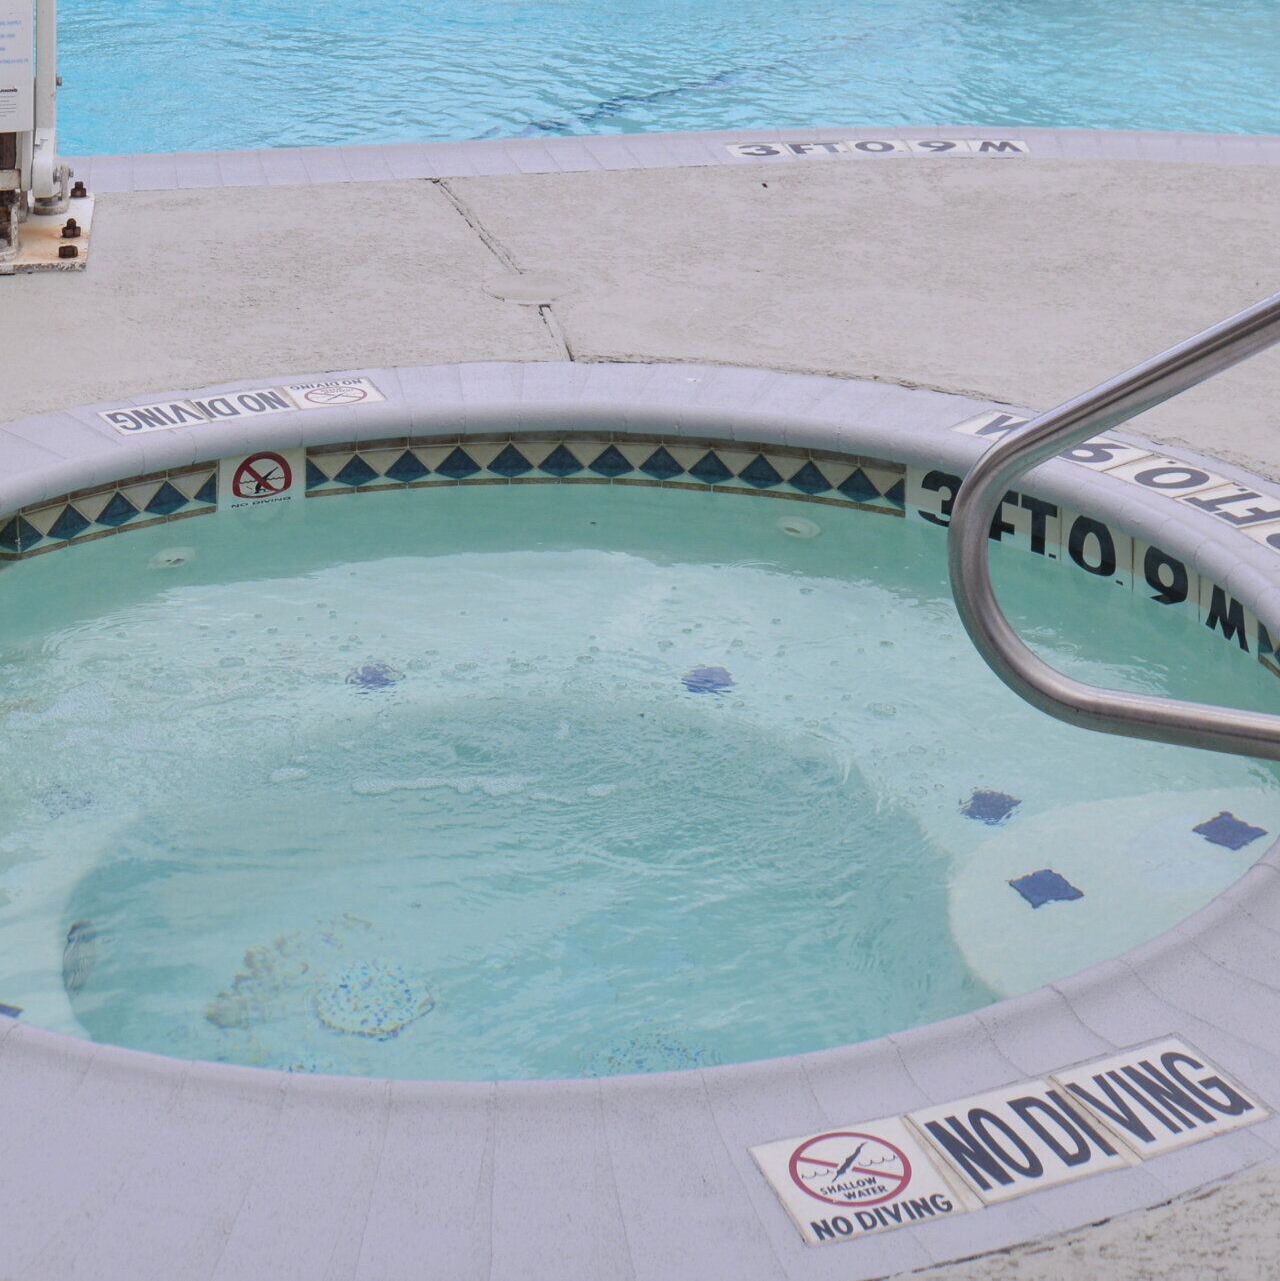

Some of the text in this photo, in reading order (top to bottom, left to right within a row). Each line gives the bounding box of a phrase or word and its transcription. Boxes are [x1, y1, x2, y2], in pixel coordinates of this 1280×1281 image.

[740, 144, 781, 156] 3
[979, 141, 1023, 153] M
[289, 377, 363, 391] NO DIVING
[105, 390, 291, 431] NO DIVING
[918, 470, 964, 528] 3
[1206, 583, 1250, 653] M
[925, 1051, 1256, 1192] NO DIVING
[820, 1176, 877, 1196] SHALLOW
[844, 1184, 888, 1201] WATER
[810, 1193, 954, 1241] NO DIVING
